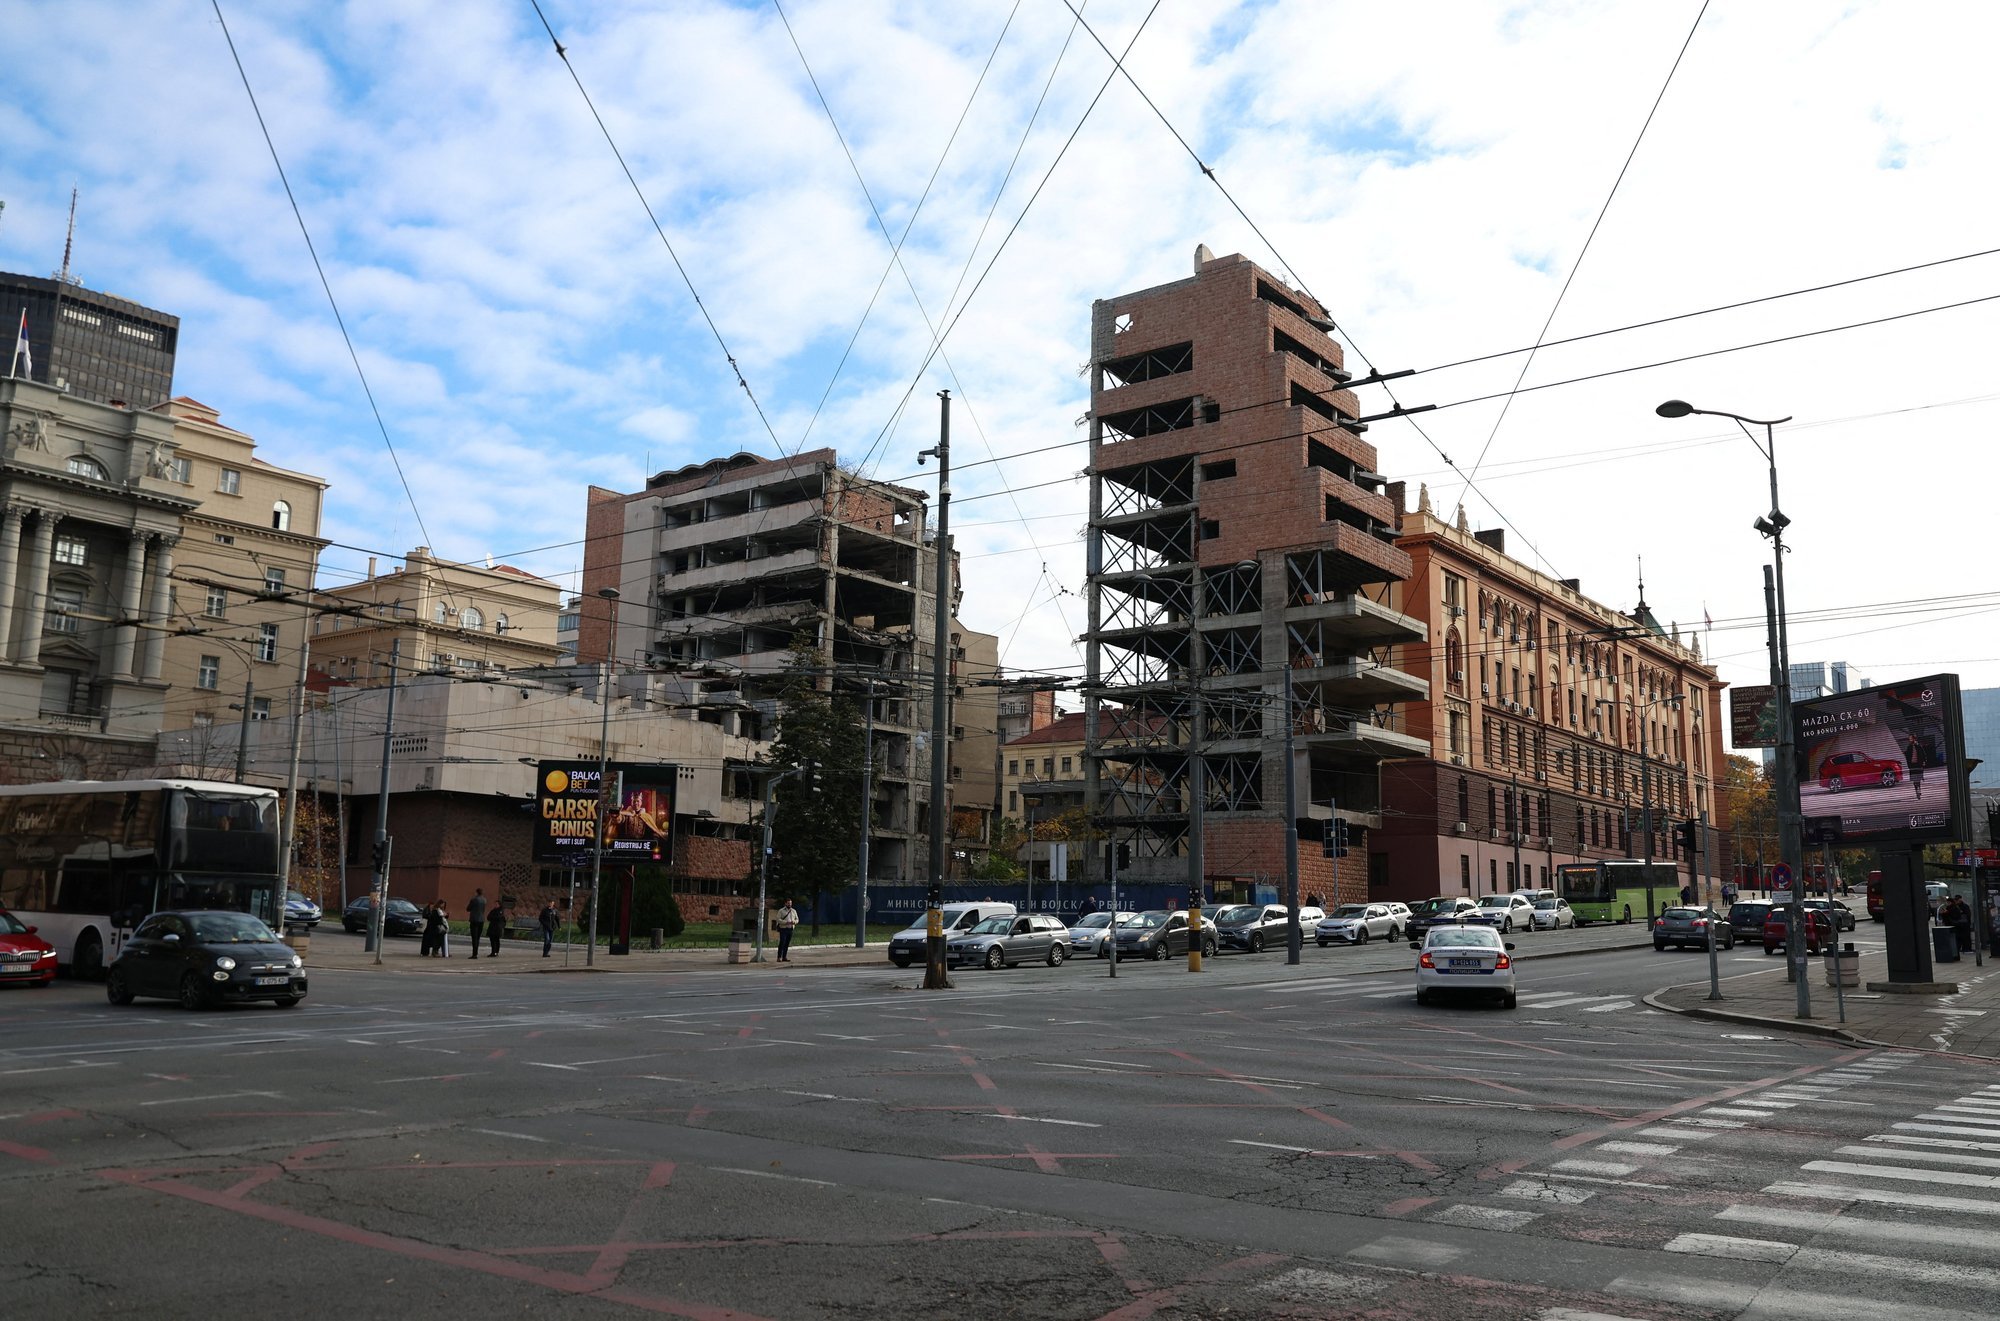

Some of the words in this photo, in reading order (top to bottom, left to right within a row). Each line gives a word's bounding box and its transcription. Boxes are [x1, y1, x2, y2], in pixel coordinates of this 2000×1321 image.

[1802, 714, 1836, 727] MAZDA
[1839, 708, 1870, 721] CX-60
[1817, 726, 1837, 735] BONUS
[571, 770, 601, 780] BALKA
[571, 780, 588, 789] BET
[543, 798, 599, 820] CARSK
[550, 819, 595, 837] BONUS
[614, 841, 643, 849] REGISTRUJ
[1098, 900, 1136, 911] РБИЈЕ
